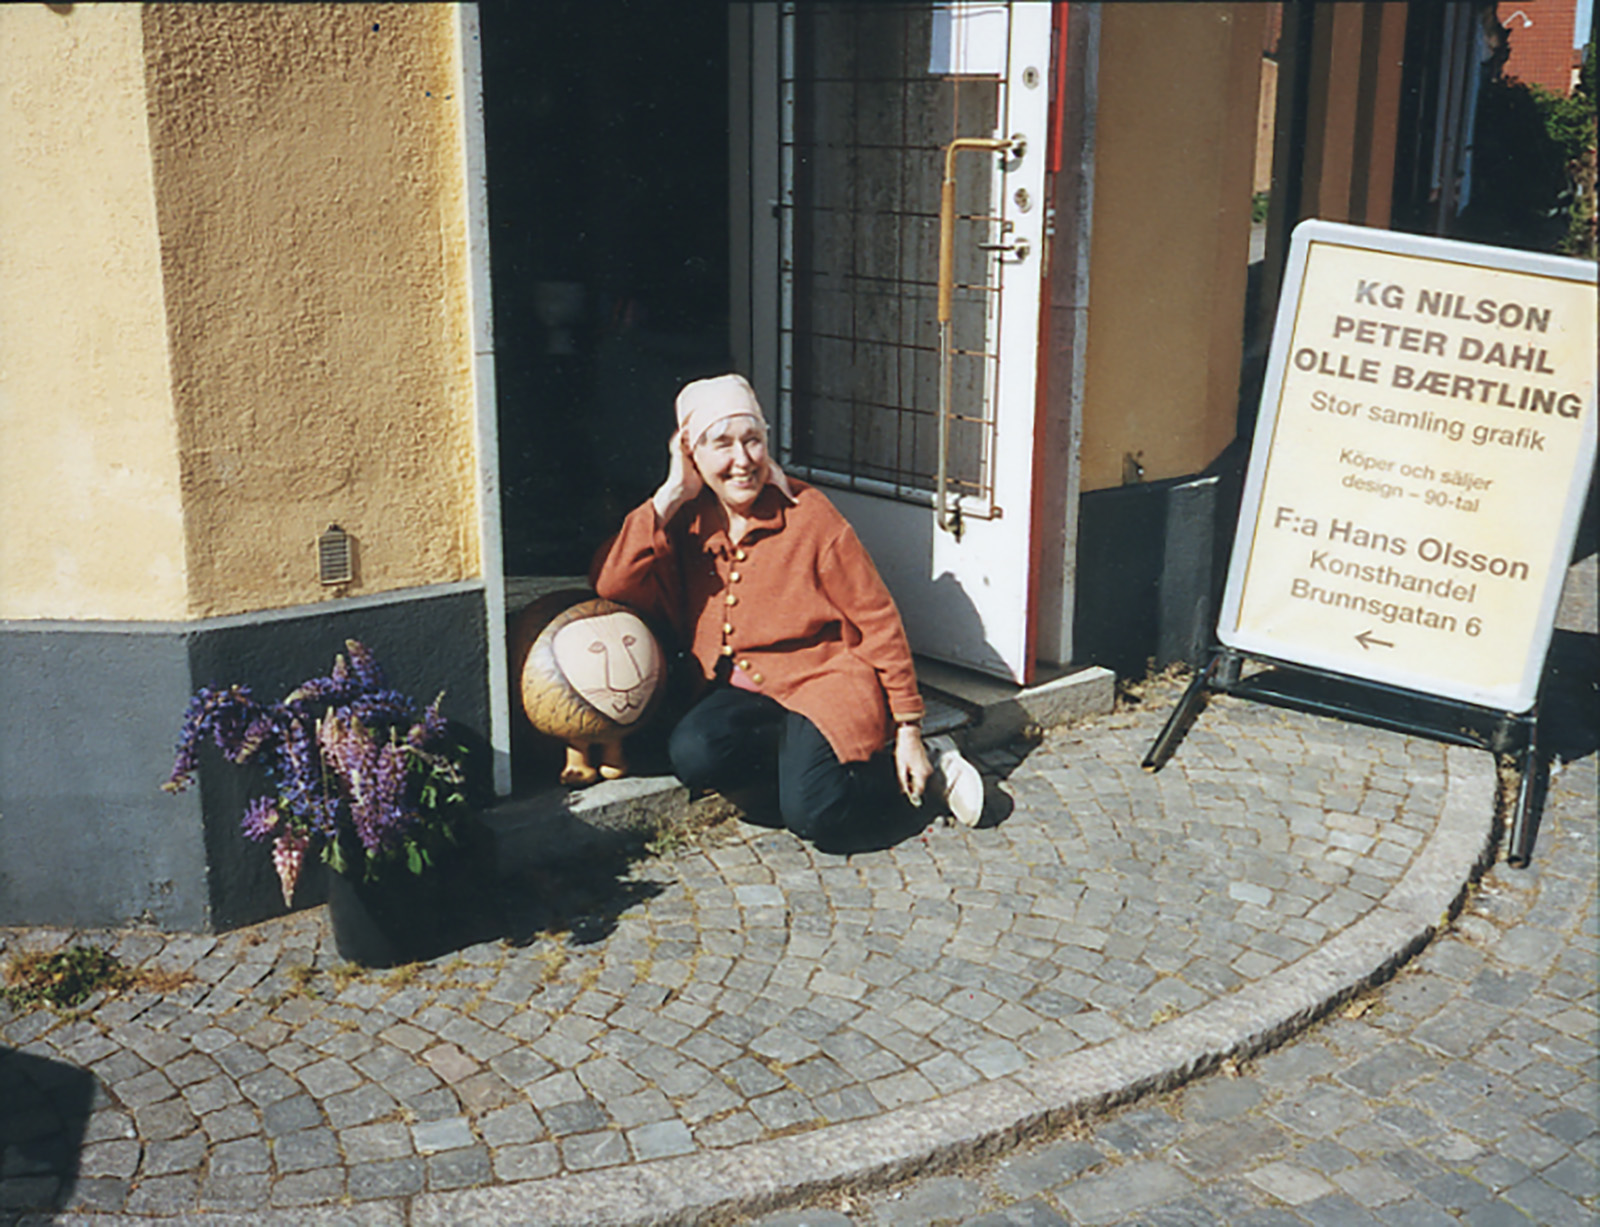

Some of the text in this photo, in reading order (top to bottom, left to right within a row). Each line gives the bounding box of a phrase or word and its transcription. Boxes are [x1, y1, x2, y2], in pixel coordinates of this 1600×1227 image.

[1355, 280, 1551, 333] KG NILSON
[1332, 315, 1555, 375] PETER DAHL
[1294, 348, 1582, 419] OLLE BÆRTLING
[1311, 390, 1546, 452] Stor samling grafik
[1339, 448, 1494, 492] Köper och säljer
[1342, 473, 1403, 499] design
[1424, 489, 1479, 513] 90-tal
[1273, 506, 1530, 581] F:a Hans Olsson
[1309, 550, 1477, 604] Konsthandel
[1290, 578, 1483, 637] Brunnsgatan 6
